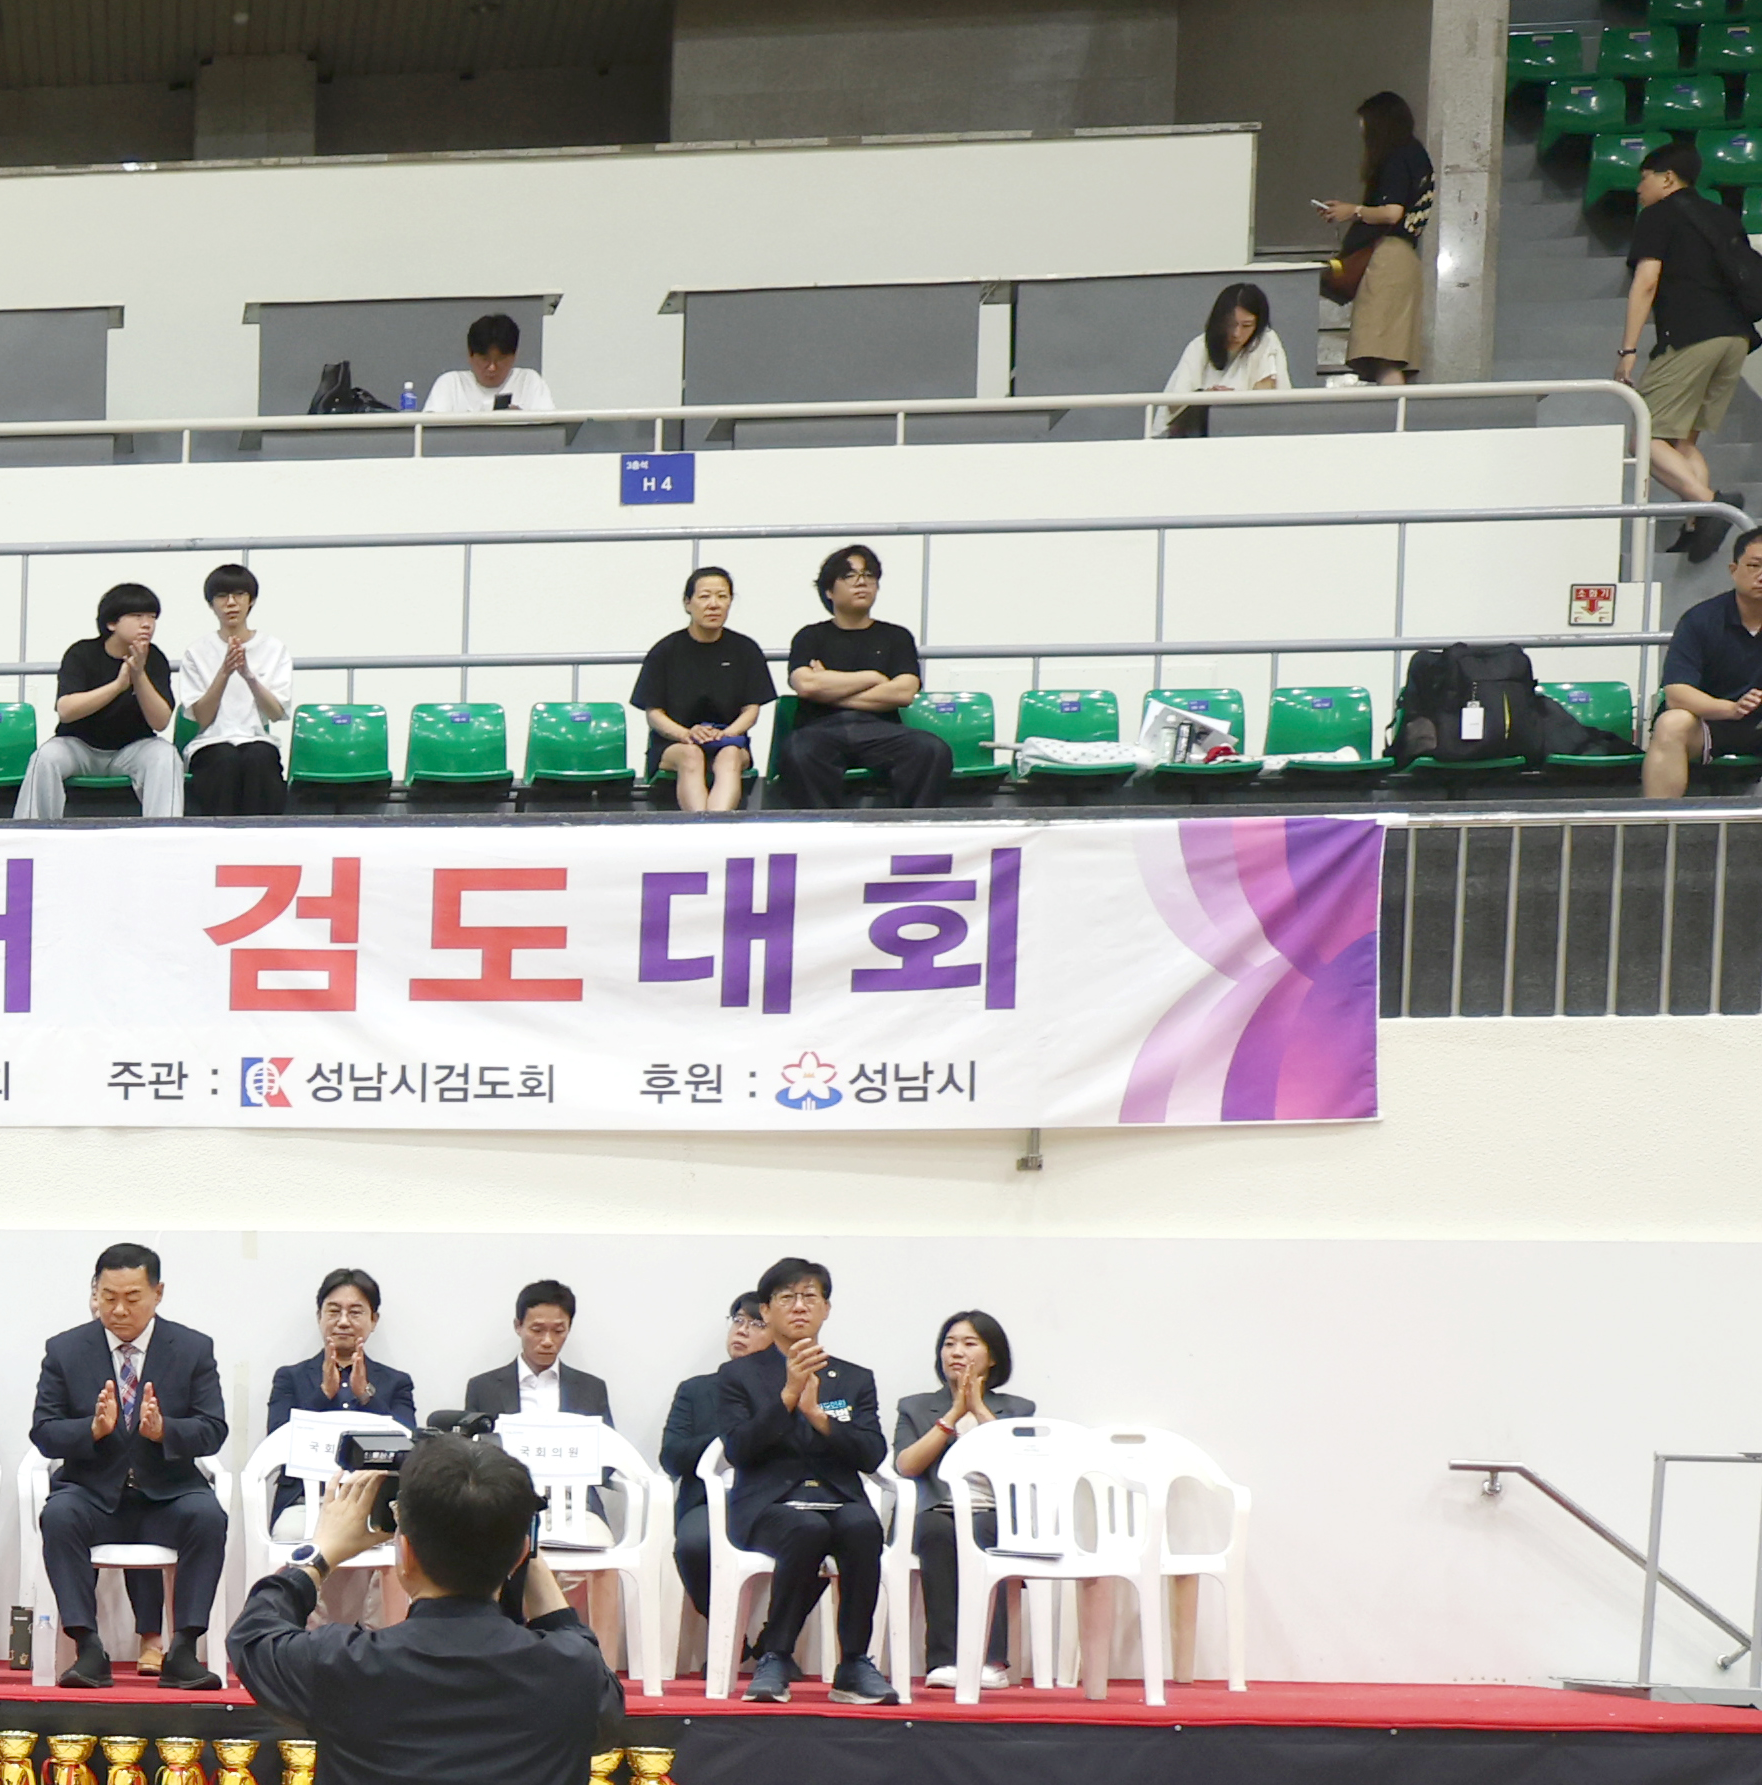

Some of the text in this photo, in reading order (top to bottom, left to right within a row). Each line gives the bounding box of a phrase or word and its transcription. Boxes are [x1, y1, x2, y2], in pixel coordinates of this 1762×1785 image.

[642, 475, 673, 491] H 4
[203, 847, 1022, 1014] 검도대회
[106, 1061, 188, 1102] 주관
[305, 1061, 556, 1105] 성남시검도회
[639, 1062, 724, 1105] 후원
[848, 1060, 978, 1105] 성남시
[520, 1446, 579, 1459] 국회의원
